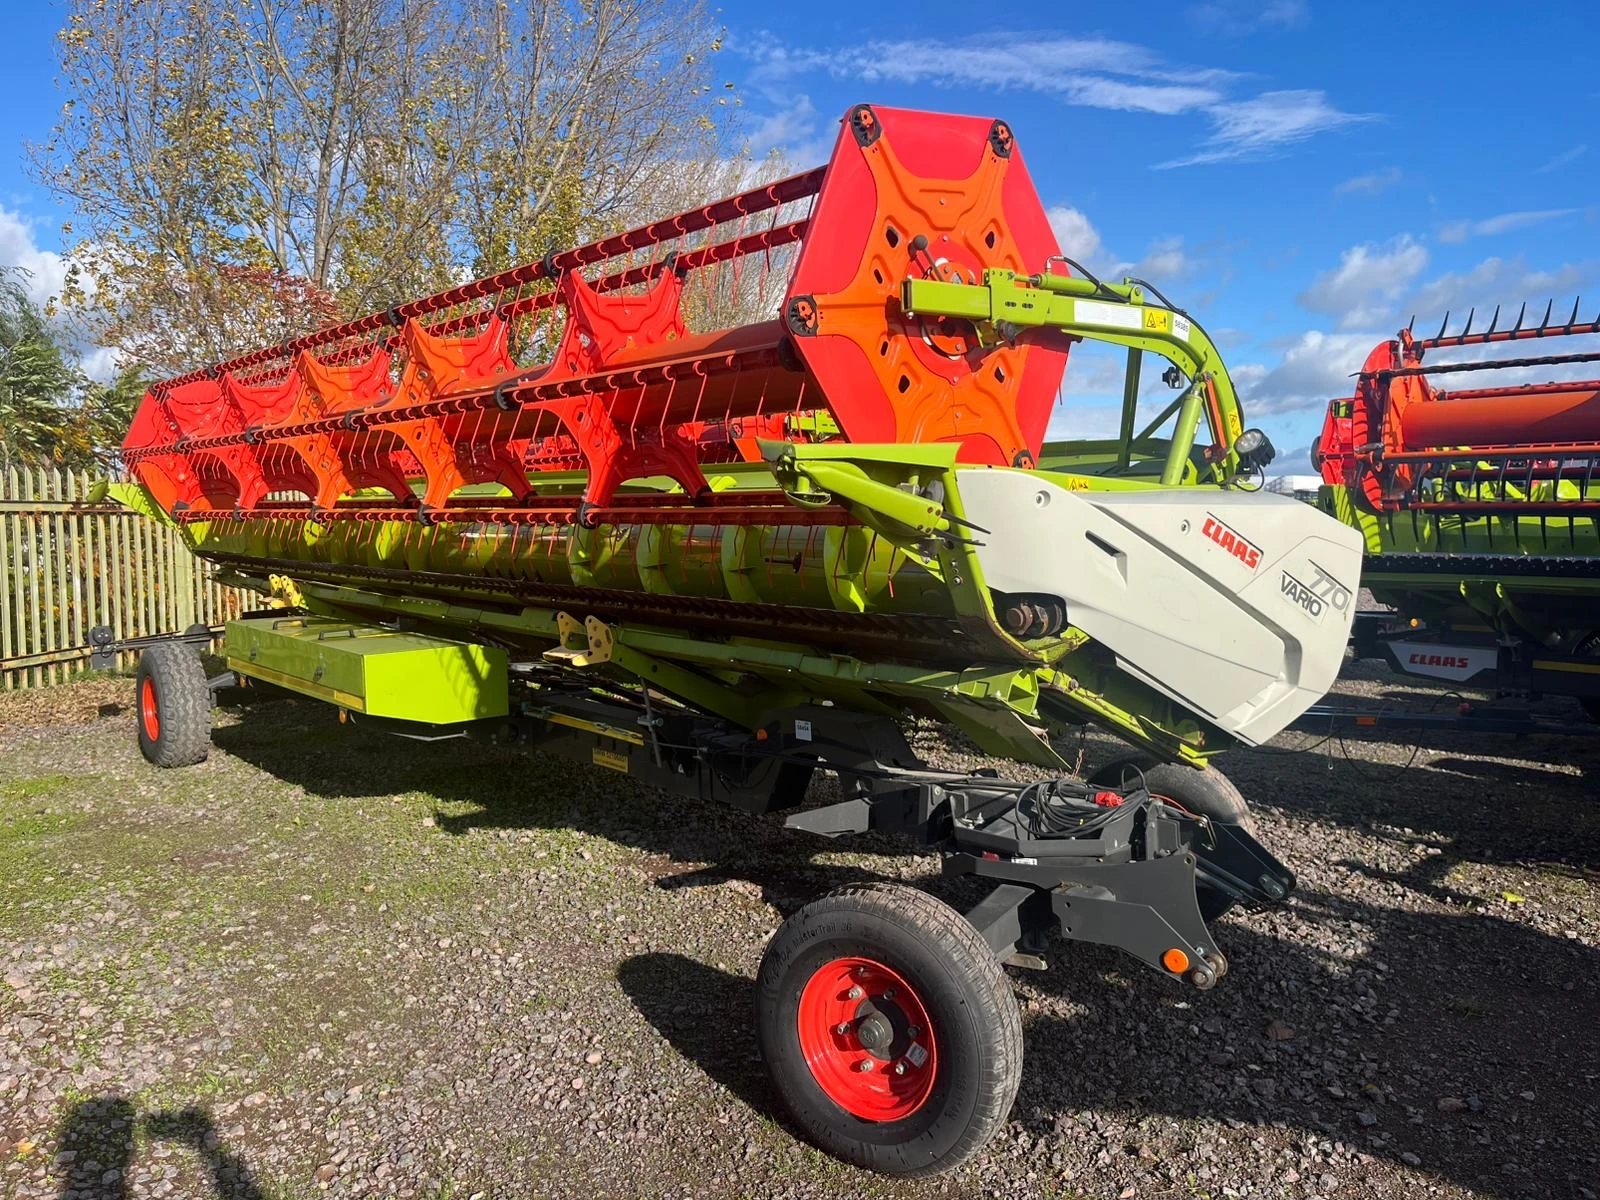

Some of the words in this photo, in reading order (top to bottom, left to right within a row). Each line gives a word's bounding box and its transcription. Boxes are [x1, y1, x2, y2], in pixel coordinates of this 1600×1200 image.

[1202, 518, 1259, 569] CLAAS
[1280, 574, 1323, 617] VARIO
[1309, 568, 1348, 611] 770
[1409, 654, 1469, 668] CLAAS
